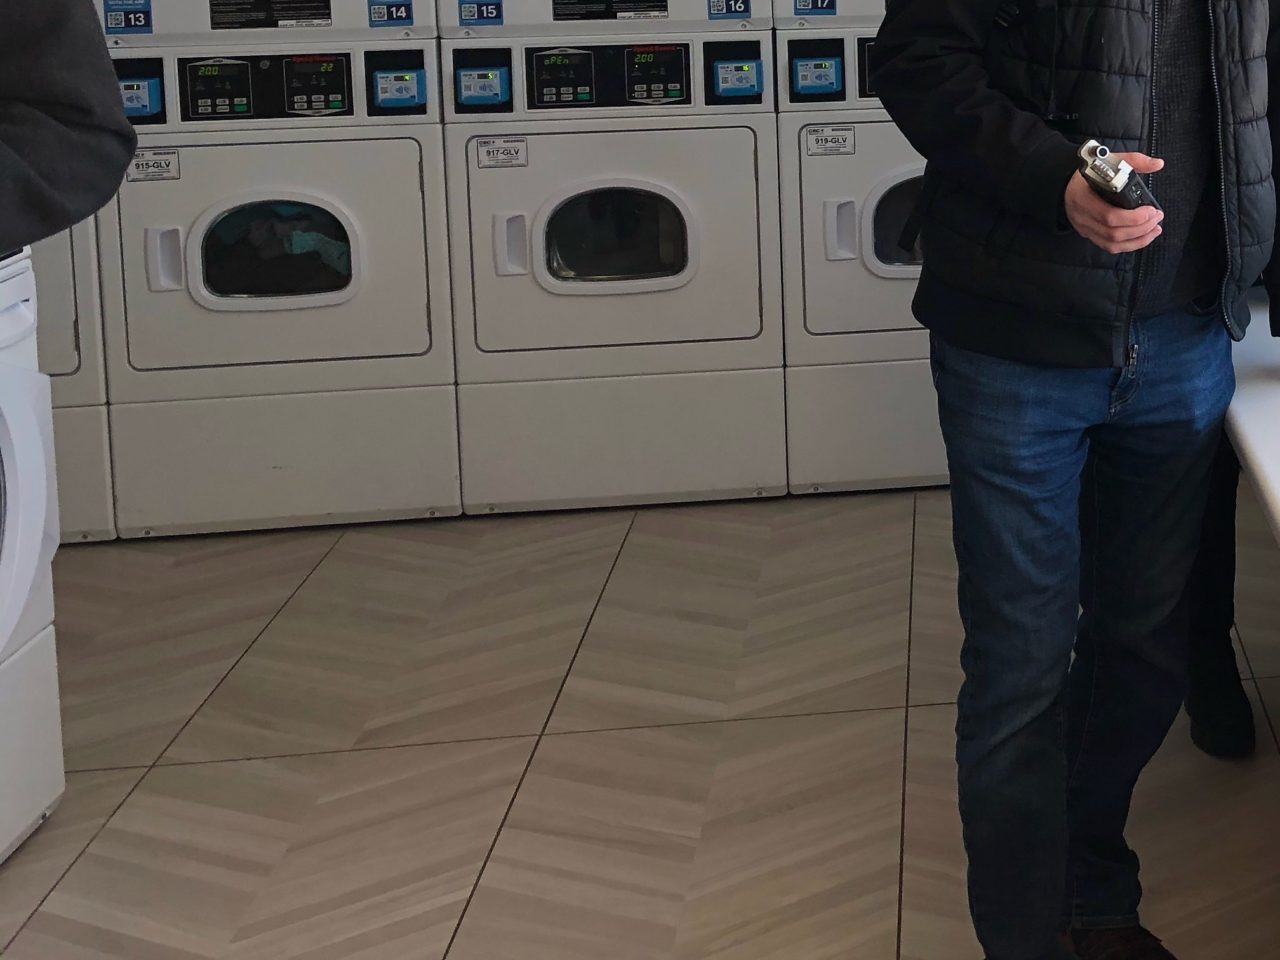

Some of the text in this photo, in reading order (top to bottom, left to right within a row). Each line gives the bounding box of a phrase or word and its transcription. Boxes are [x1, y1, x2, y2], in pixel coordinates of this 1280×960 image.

[390, 6, 407, 18] 14
[481, 5, 497, 17] 15
[729, 0, 745, 12] 16
[128, 13, 145, 25] 13
[321, 63, 333, 72] 22
[486, 148, 520, 157] 917-GLV
[134, 161, 171, 170] 915-GLV
